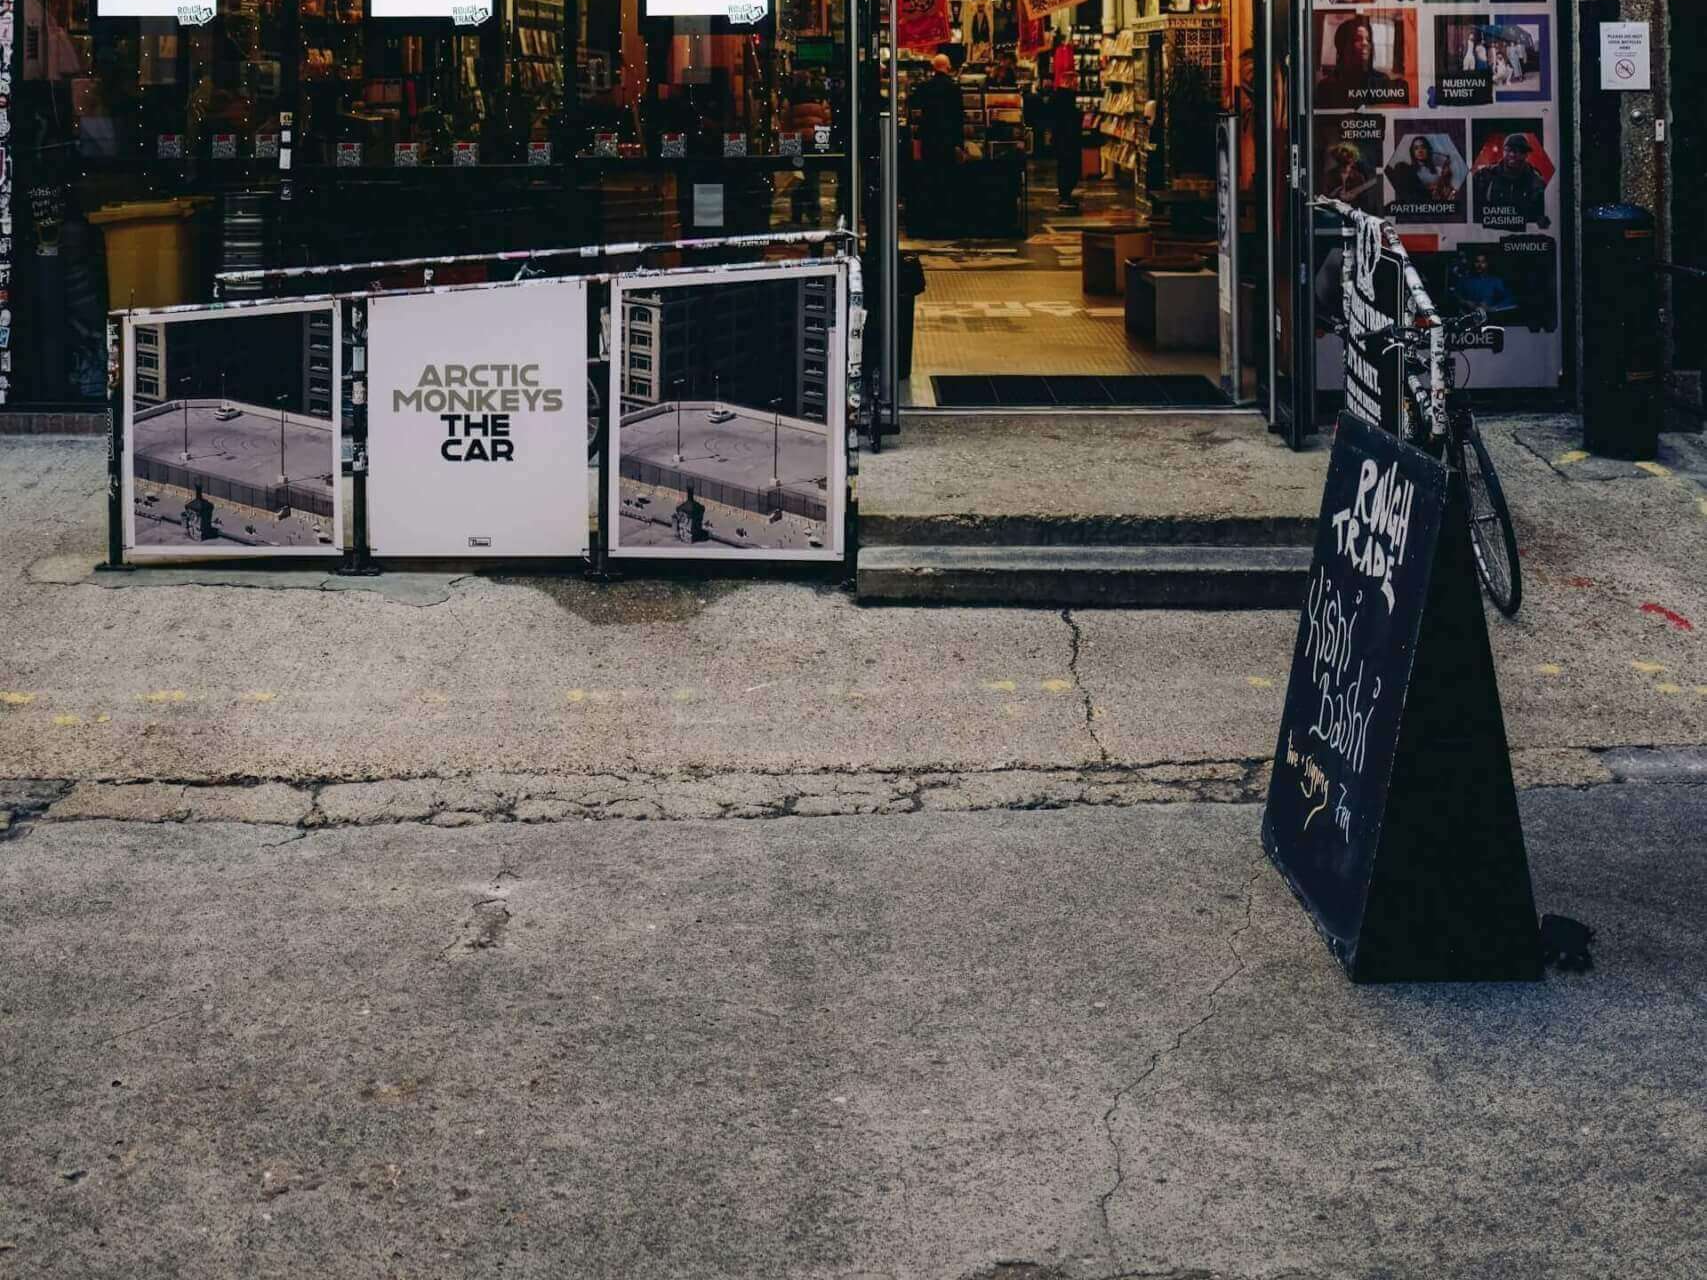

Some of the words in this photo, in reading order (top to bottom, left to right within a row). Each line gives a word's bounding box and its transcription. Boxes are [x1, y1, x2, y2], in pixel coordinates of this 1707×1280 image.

[1442, 78, 1486, 88] NUBIYAN
[1348, 88, 1370, 99] KAY
[1370, 88, 1405, 98] YOUNG
[1442, 88, 1475, 98] TWIST
[1341, 119, 1377, 129] OSCAR
[1341, 129, 1382, 139] JEROME
[1390, 203, 1456, 214] PARTHENOPE
[1482, 206, 1518, 216] DANIEL
[1482, 215, 1525, 225] CASIMIR
[1503, 241, 1549, 252] SWINDLE
[418, 364, 540, 388] ARCTIC
[393, 388, 563, 413] MONKEYS
[440, 413, 511, 437] THE
[441, 438, 514, 462] CAR
[1332, 508, 1396, 615] TRADE
[1309, 659, 1381, 773] Bashi
